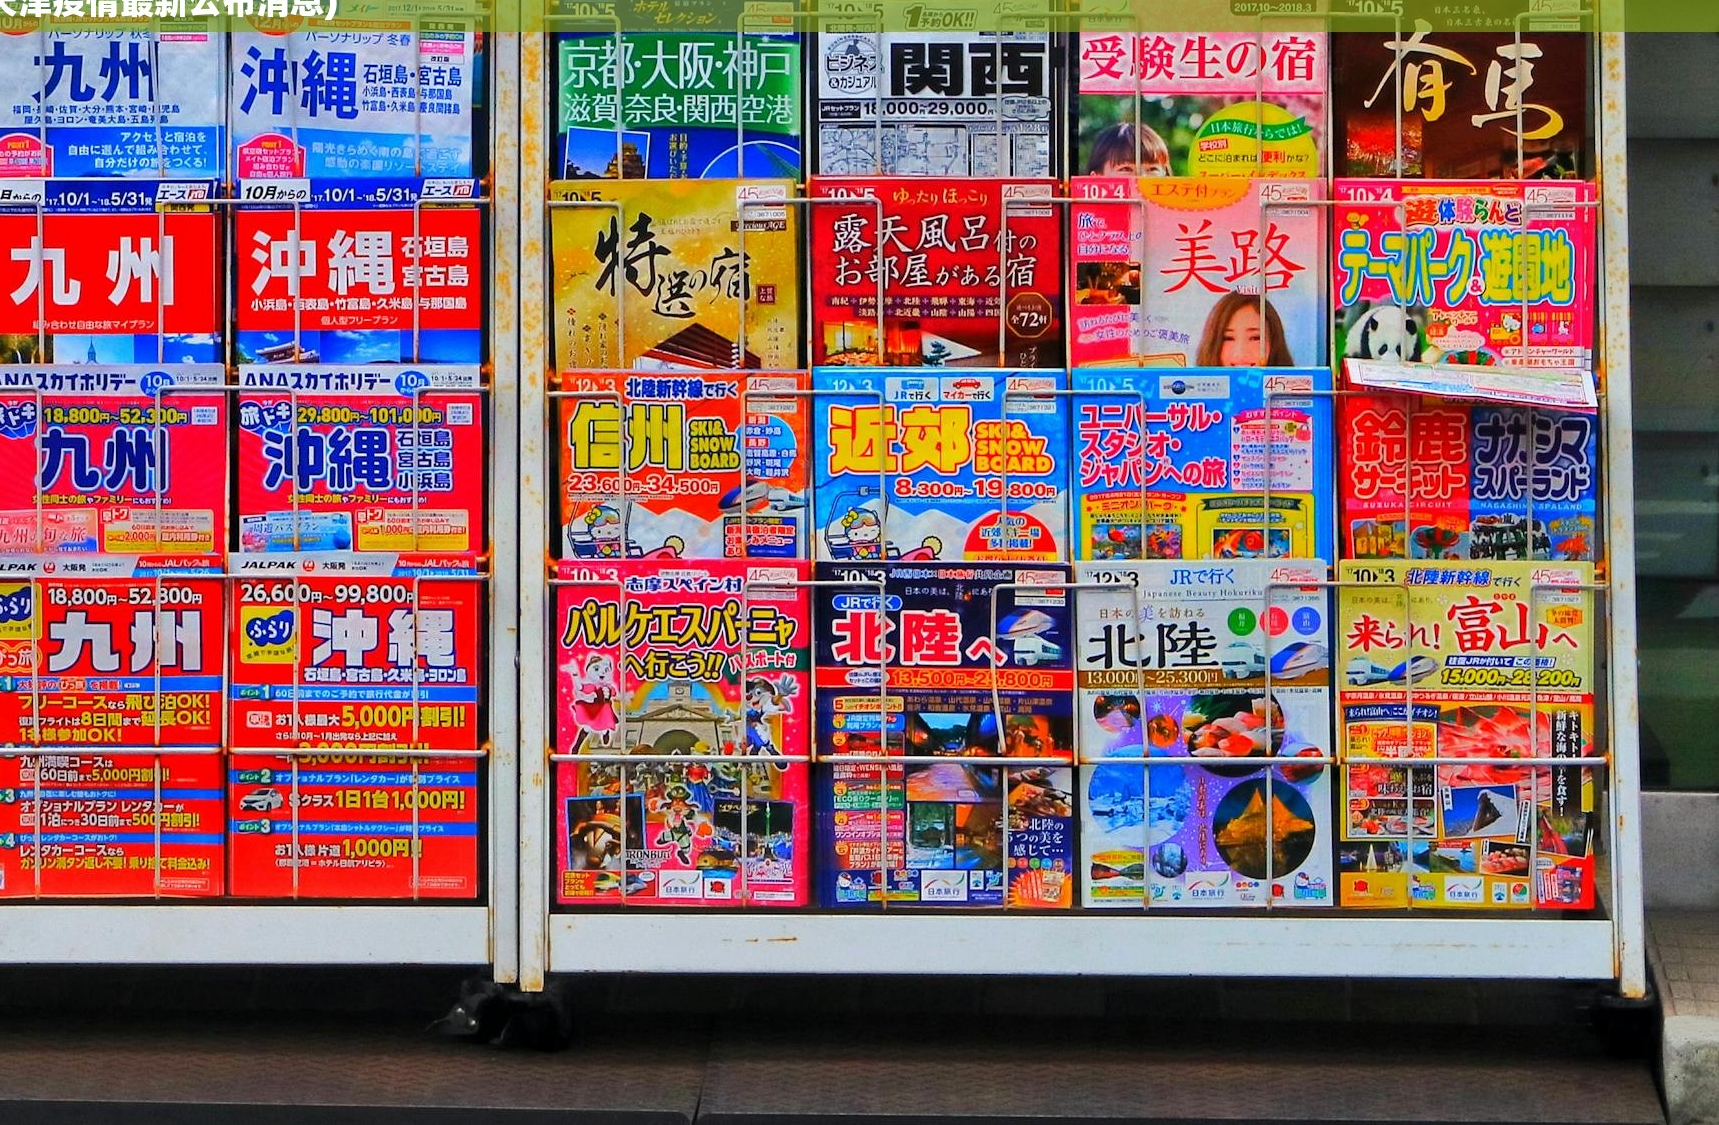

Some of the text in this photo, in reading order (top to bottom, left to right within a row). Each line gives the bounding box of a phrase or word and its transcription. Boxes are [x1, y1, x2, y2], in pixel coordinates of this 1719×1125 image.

[563, 40, 794, 92] 京都・大阪・神戸
[890, 42, 1047, 97] 関西
[1081, 36, 1316, 83] 受験生の宿
[362, 64, 462, 87] 石垣島・宮古島
[1200, 138, 1228, 152] 学校別
[893, 188, 990, 207] ゆったり ほっこり
[250, 229, 396, 296] 沖縄
[1160, 217, 1307, 296] 美路
[9, 235, 175, 307] 九州
[834, 253, 1036, 290] お部屋がある宿
[321, 314, 399, 325] 個人型フリープラン
[626, 378, 738, 400] 北陸新幹線で行く
[942, 389, 991, 401] マイカーで行く
[568, 401, 685, 472] 信州
[828, 404, 973, 477] 近郊
[1352, 408, 1469, 465] 鈴鹿
[398, 451, 452, 469] 宮古島
[689, 452, 740, 471] BOARD
[62, 562, 87, 572] 大阪発
[1169, 567, 1235, 587] JRで行く
[1404, 567, 1521, 590] 北陸新幹線で行く
[1142, 588, 1188, 599] Japanese
[1192, 588, 1226, 599] Beauty
[564, 604, 798, 649] パルケエスパーニャ
[48, 610, 203, 673] 九州
[311, 609, 457, 669] 沖縄
[1087, 622, 1221, 671] 北陸
[1029, 818, 1064, 834] 北陸の
[19, 845, 124, 857] レンタカーコースなら
[665, 884, 698, 896] 日本旅行
[1190, 887, 1226, 899] 日本旅行
